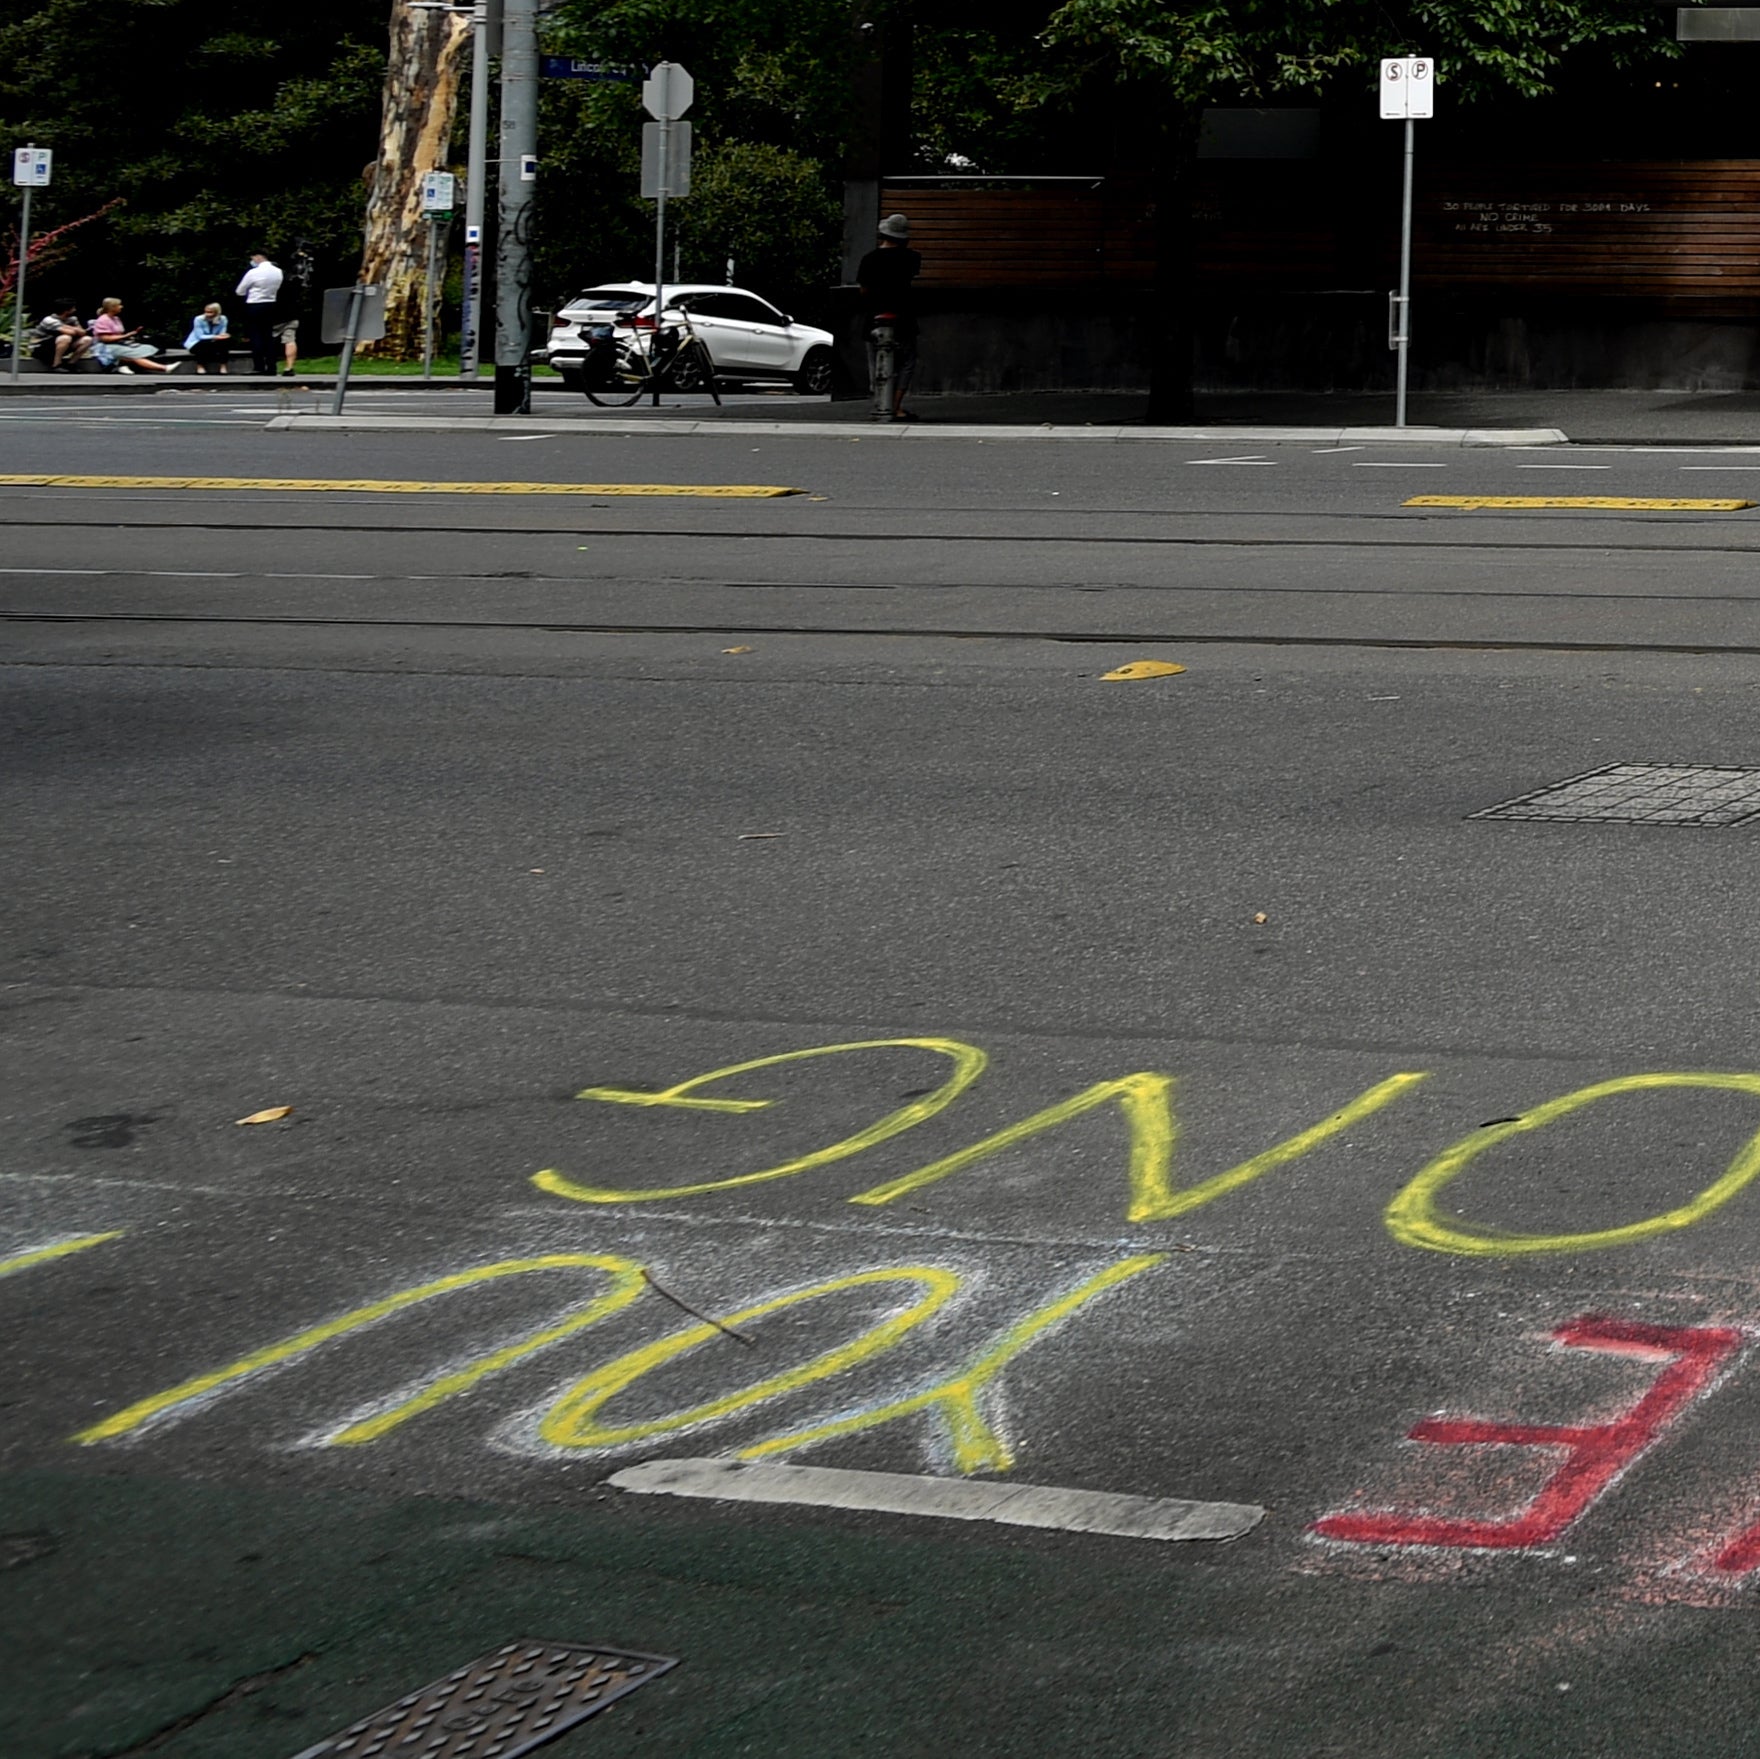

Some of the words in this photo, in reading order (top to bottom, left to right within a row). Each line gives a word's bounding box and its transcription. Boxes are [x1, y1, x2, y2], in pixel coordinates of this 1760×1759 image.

[1443, 203, 1459, 211] 30
[1620, 203, 1650, 211] DAYS
[1480, 213, 1498, 221] NO
[1505, 213, 1539, 221] CRIME
[1532, 223, 1552, 232] 35
